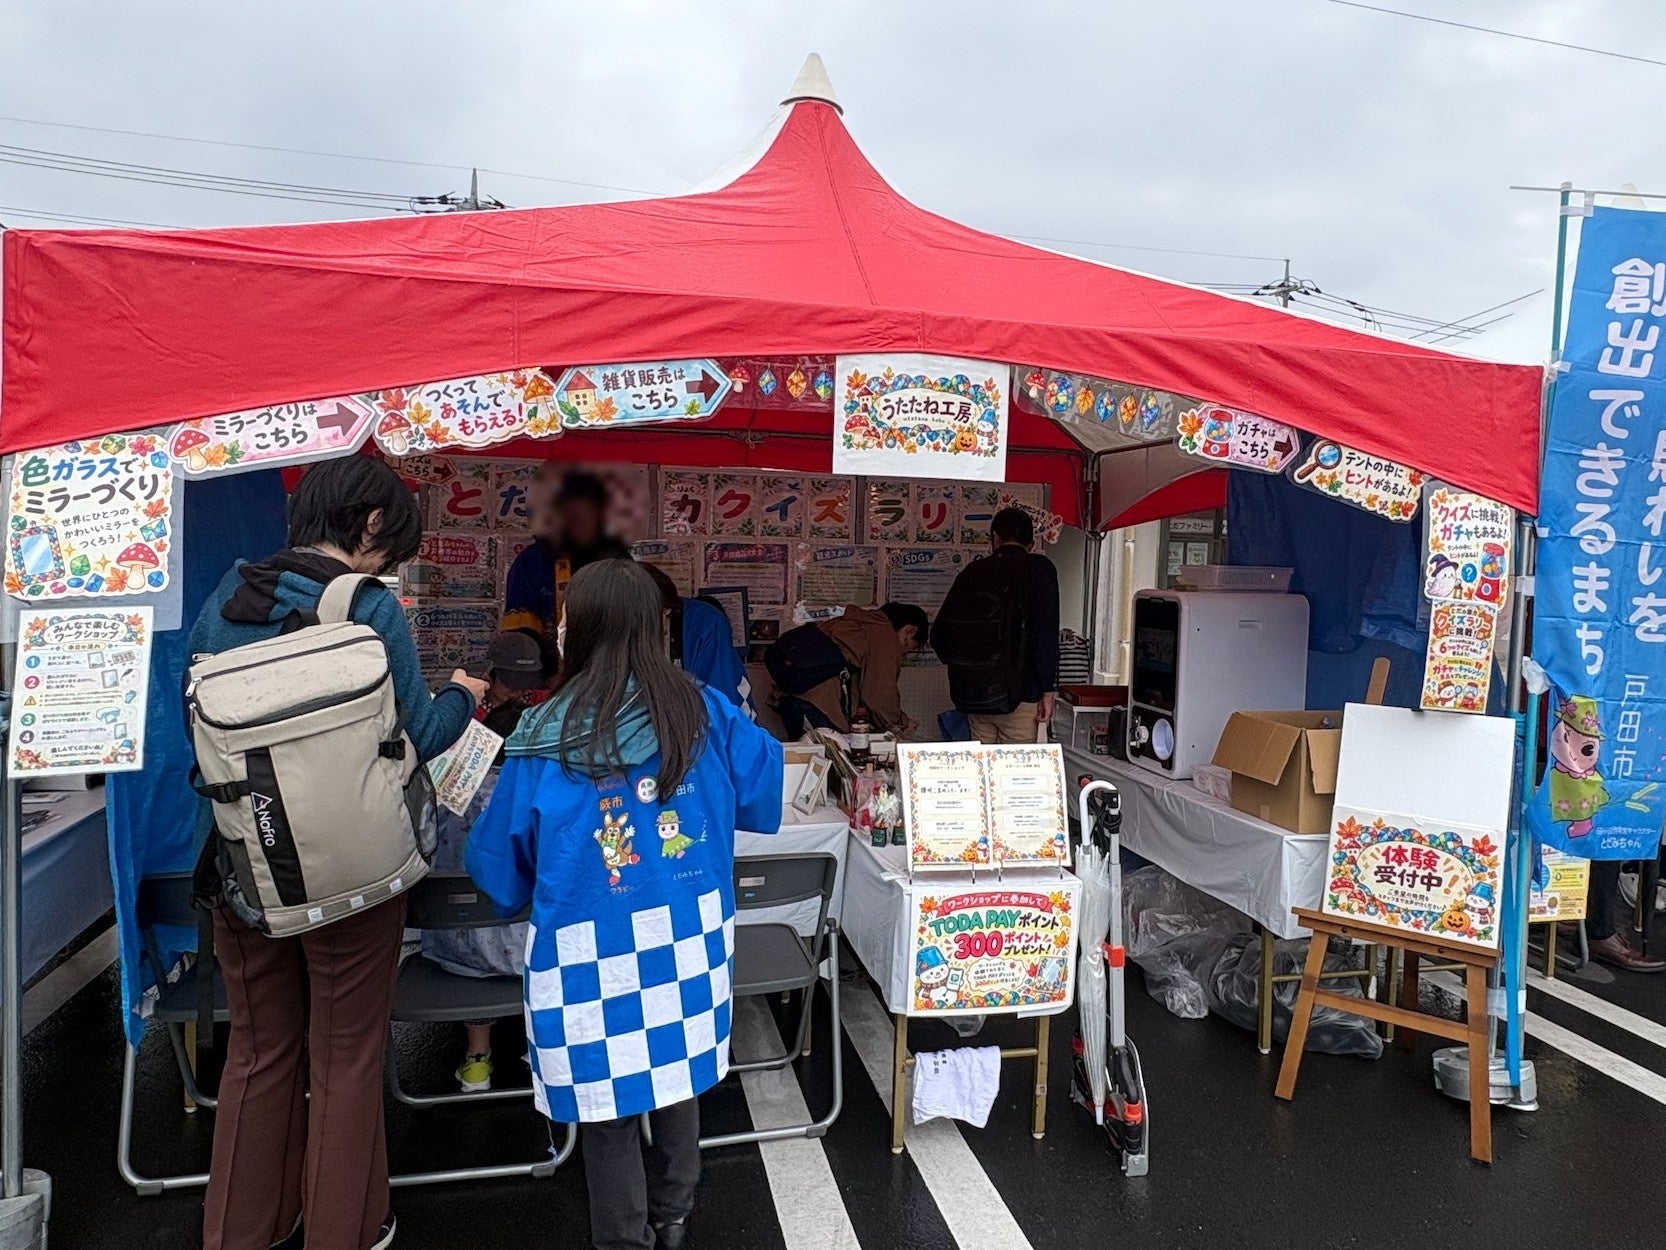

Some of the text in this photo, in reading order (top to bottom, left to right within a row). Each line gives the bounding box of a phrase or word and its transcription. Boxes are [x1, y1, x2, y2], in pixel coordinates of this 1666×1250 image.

[425, 380, 479, 402] つくって
[602, 366, 686, 393] 雑貨販売は
[439, 391, 504, 420] あそんで
[631, 388, 678, 411] こちら
[882, 396, 971, 424] うたたね工房
[213, 402, 317, 436] ミラーづくりは
[1237, 420, 1276, 438] ガチャは
[254, 423, 308, 450] こちら
[1239, 440, 1269, 459] こちら
[20, 455, 139, 487] 色ガラスで
[406, 465, 430, 477] こちら
[1345, 452, 1404, 479] テントの中に
[1570, 257, 1666, 676] 創出できるまち
[25, 474, 159, 514] ミラーづくり
[61, 507, 129, 527] 世界にひとつの
[64, 518, 140, 539] かわいいミラーを
[904, 553, 931, 565] SDGs
[53, 621, 120, 633] みんなで楽しむ
[1437, 613, 1490, 629] クイズラリー
[54, 631, 119, 642] ワークショップ
[1612, 674, 1649, 779] 戸田市
[469, 747, 484, 770] TODA
[1381, 844, 1441, 873] 体験
[1374, 865, 1443, 892] 受付中
[947, 892, 1042, 910] ワークショップに参加して
[928, 909, 1059, 937] TODA PAY ポイント
[954, 931, 1003, 960] 300
[1004, 932, 1041, 944] ポイント
